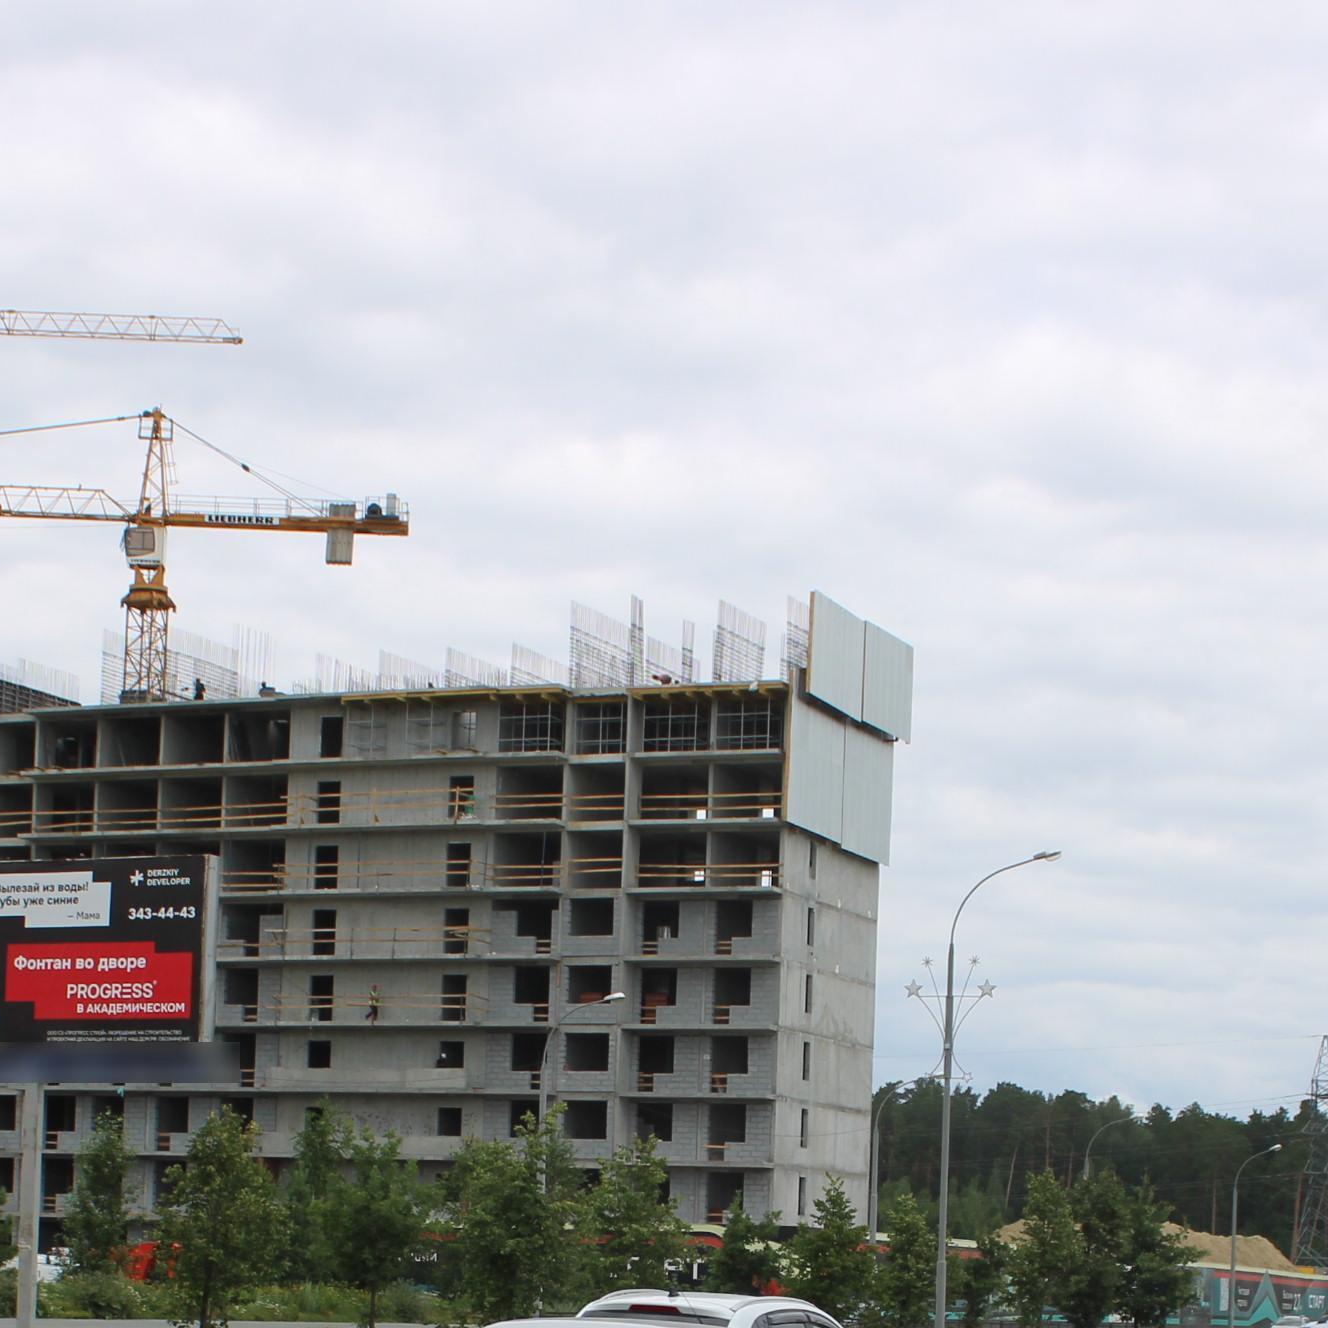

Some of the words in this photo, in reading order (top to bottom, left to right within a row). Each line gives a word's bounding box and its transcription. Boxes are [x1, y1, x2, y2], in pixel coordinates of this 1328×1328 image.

[147, 868, 180, 877] DERZKIY
[147, 877, 191, 886] DEVELOPER
[58, 882, 89, 893] воды!
[23, 898, 44, 907] уже
[47, 896, 79, 905] синие
[75, 911, 101, 920] Мама
[128, 906, 196, 920] 343-44-43
[14, 955, 71, 970] Фонтан
[75, 958, 94, 969] во
[97, 957, 147, 972] дворе
[66, 983, 153, 999] PROGRESS
[76, 1004, 84, 1013] В
[86, 1003, 185, 1015] АКАДЕМИЧЕСКОМ
